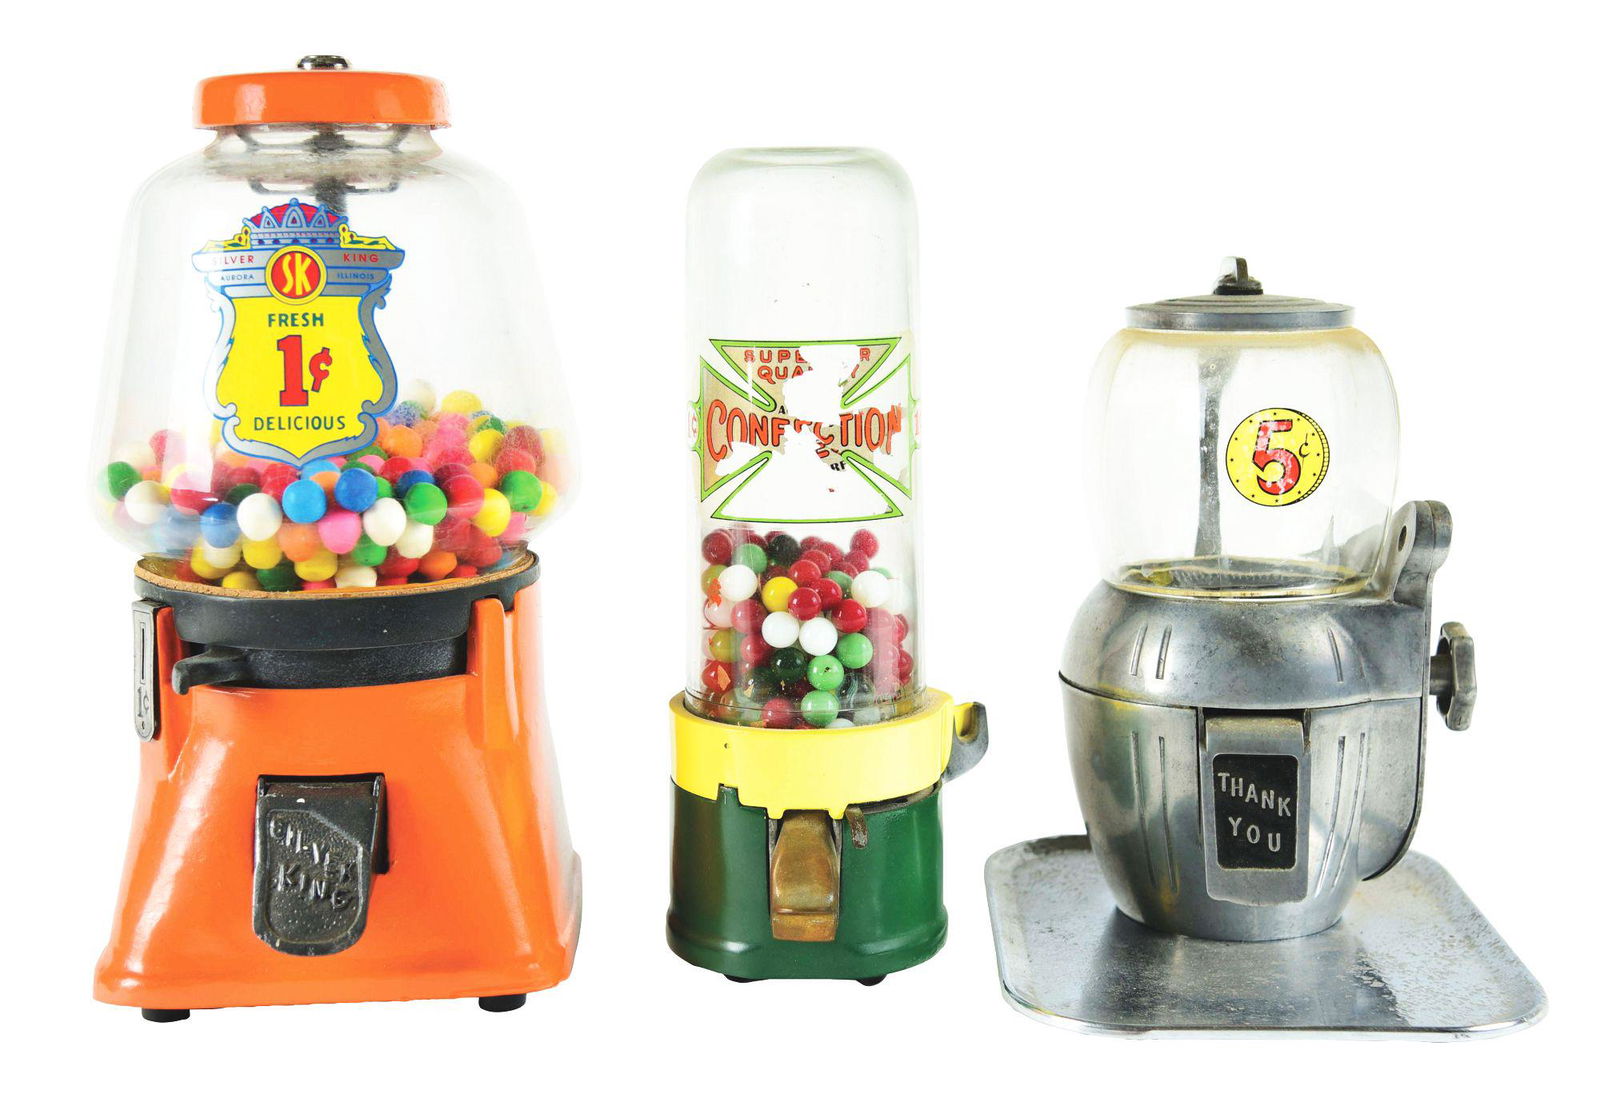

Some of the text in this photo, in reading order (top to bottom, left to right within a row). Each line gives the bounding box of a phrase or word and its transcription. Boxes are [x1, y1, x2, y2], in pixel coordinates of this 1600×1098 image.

[221, 272, 375, 281] AURORA ILLINOIS
[282, 253, 312, 296] SK
[343, 253, 379, 263] KING
[267, 312, 324, 327] FRESH
[276, 334, 333, 407] 1¢
[254, 415, 346, 431] DELICIOUS
[1217, 772, 1292, 817] THANK
[1228, 816, 1282, 853] YOU
[275, 863, 352, 911] KING
